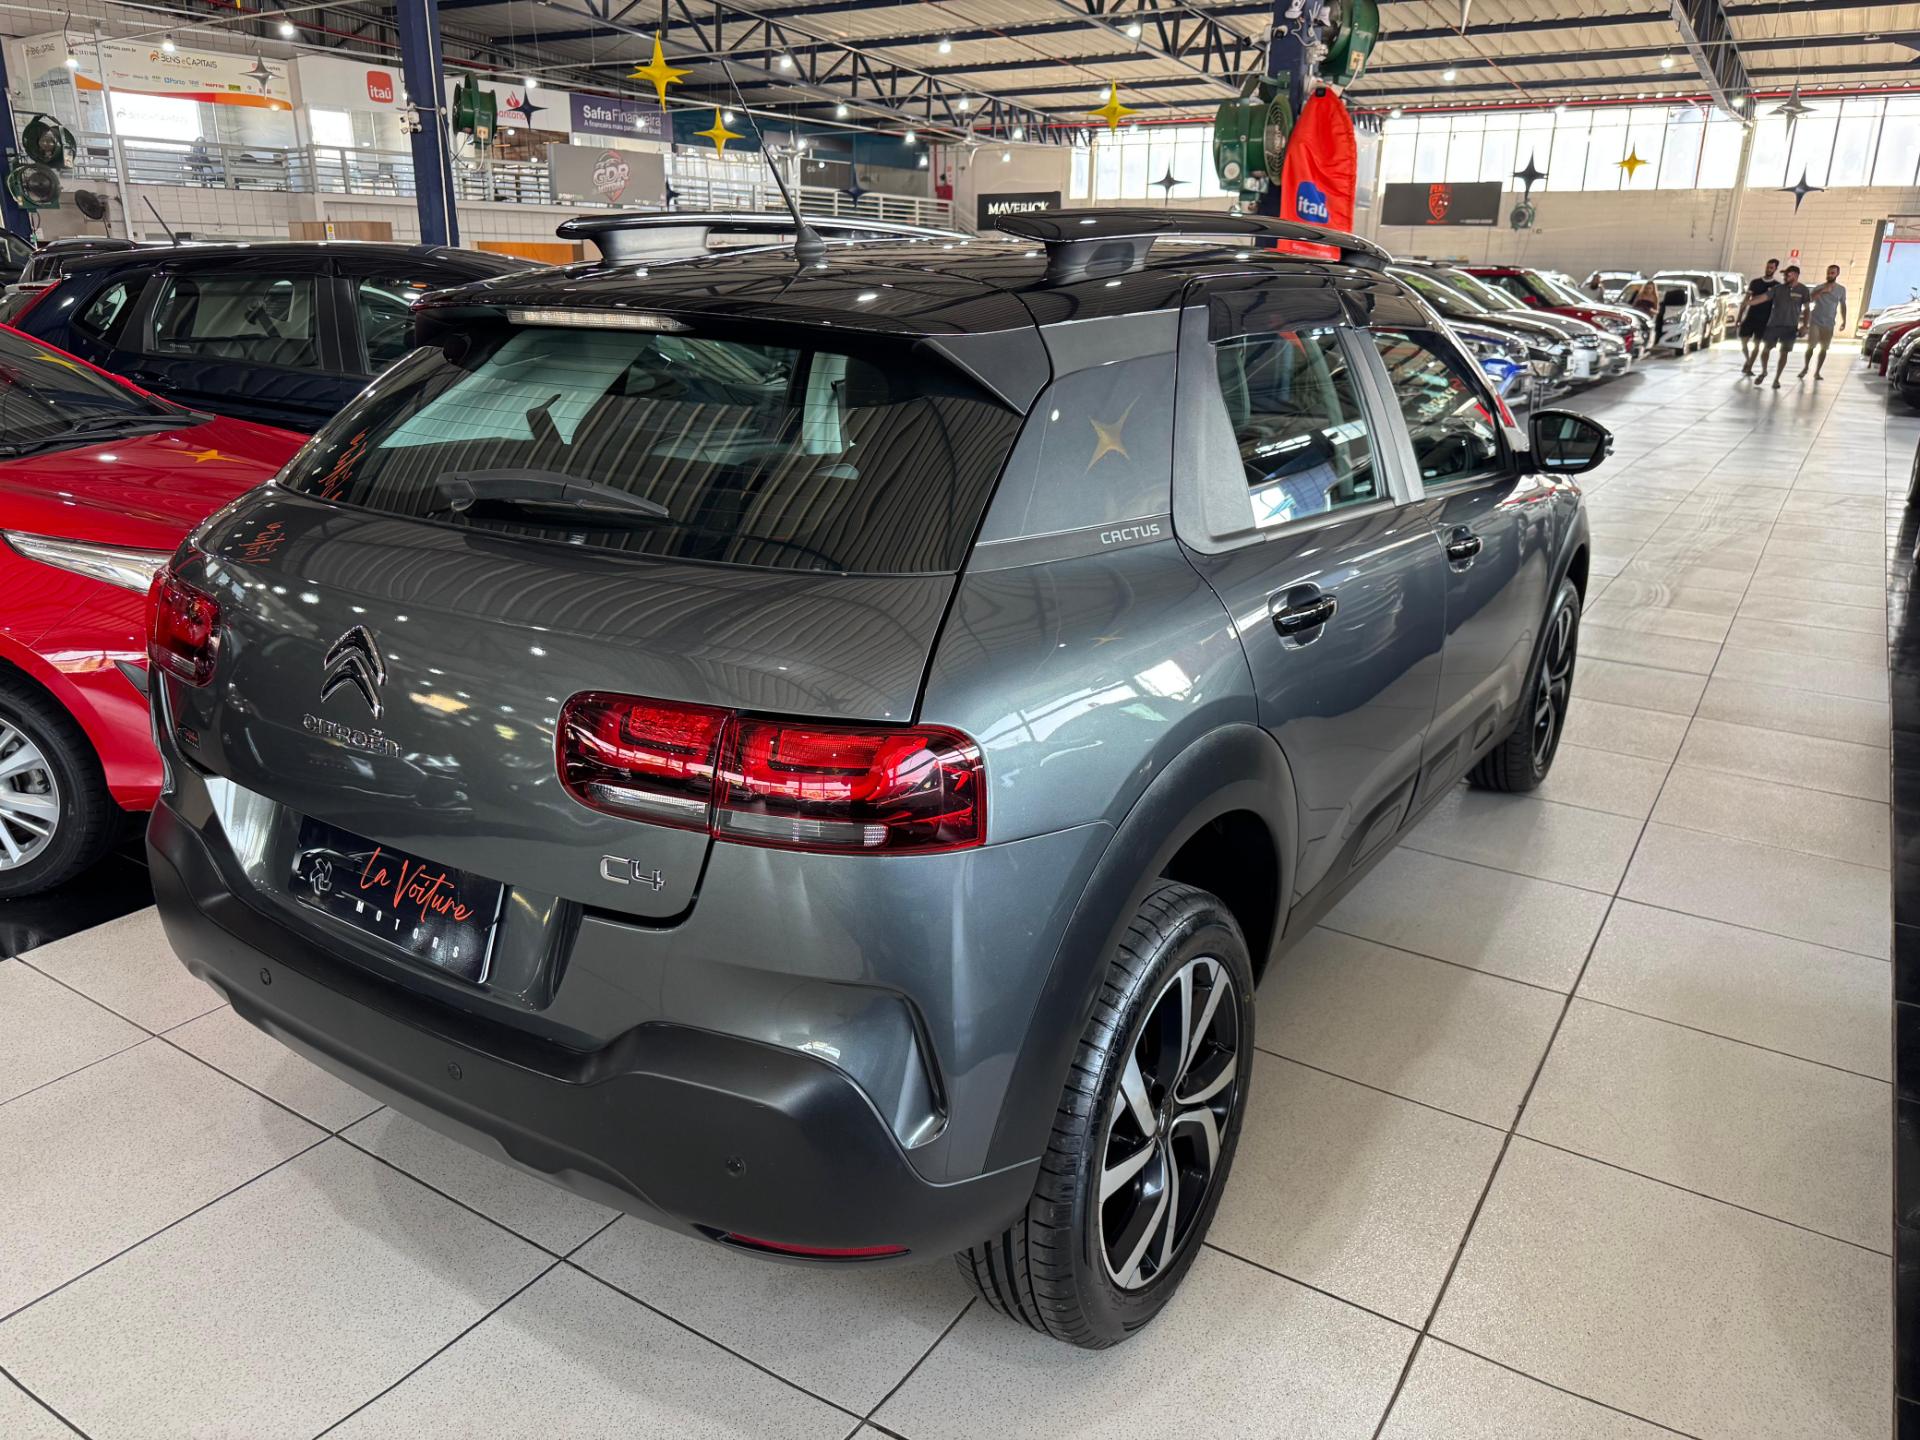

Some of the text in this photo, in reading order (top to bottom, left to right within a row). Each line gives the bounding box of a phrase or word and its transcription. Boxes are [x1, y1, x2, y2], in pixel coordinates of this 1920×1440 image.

[161, 54, 181, 64] BENS
[370, 85, 392, 99] itaú
[592, 163, 630, 186] GDR
[988, 201, 1050, 215] MAVERICK
[1297, 196, 1328, 218] itaú
[1100, 523, 1160, 544] CACTUS
[303, 713, 402, 758] CITROËN
[600, 854, 665, 891] C4
[360, 847, 473, 923] La Voiture
[356, 901, 460, 957] MOTORS
